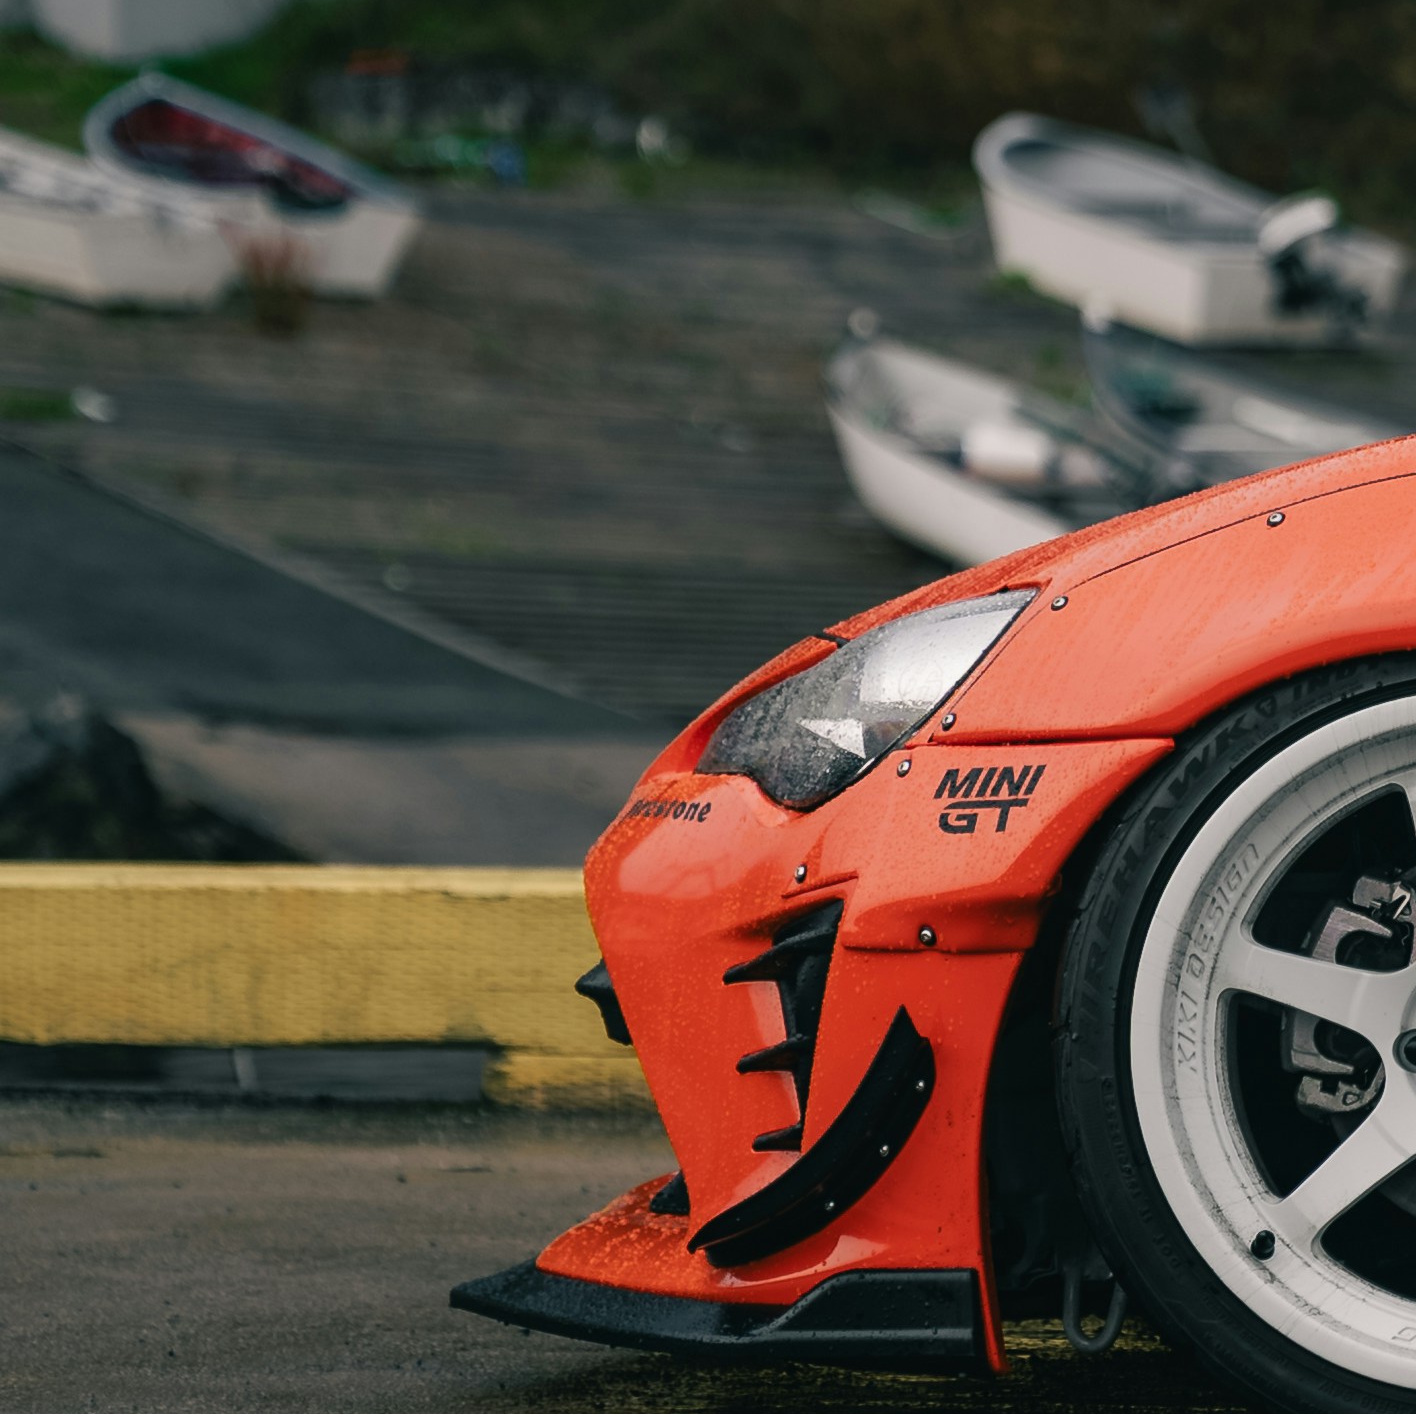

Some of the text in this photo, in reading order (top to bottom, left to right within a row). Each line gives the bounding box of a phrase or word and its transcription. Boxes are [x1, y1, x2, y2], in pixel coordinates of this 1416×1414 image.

[933, 764, 1047, 800] MINI
[619, 798, 712, 823] restone
[937, 798, 1030, 834] GT
[1185, 842, 1261, 981] DESIGN
